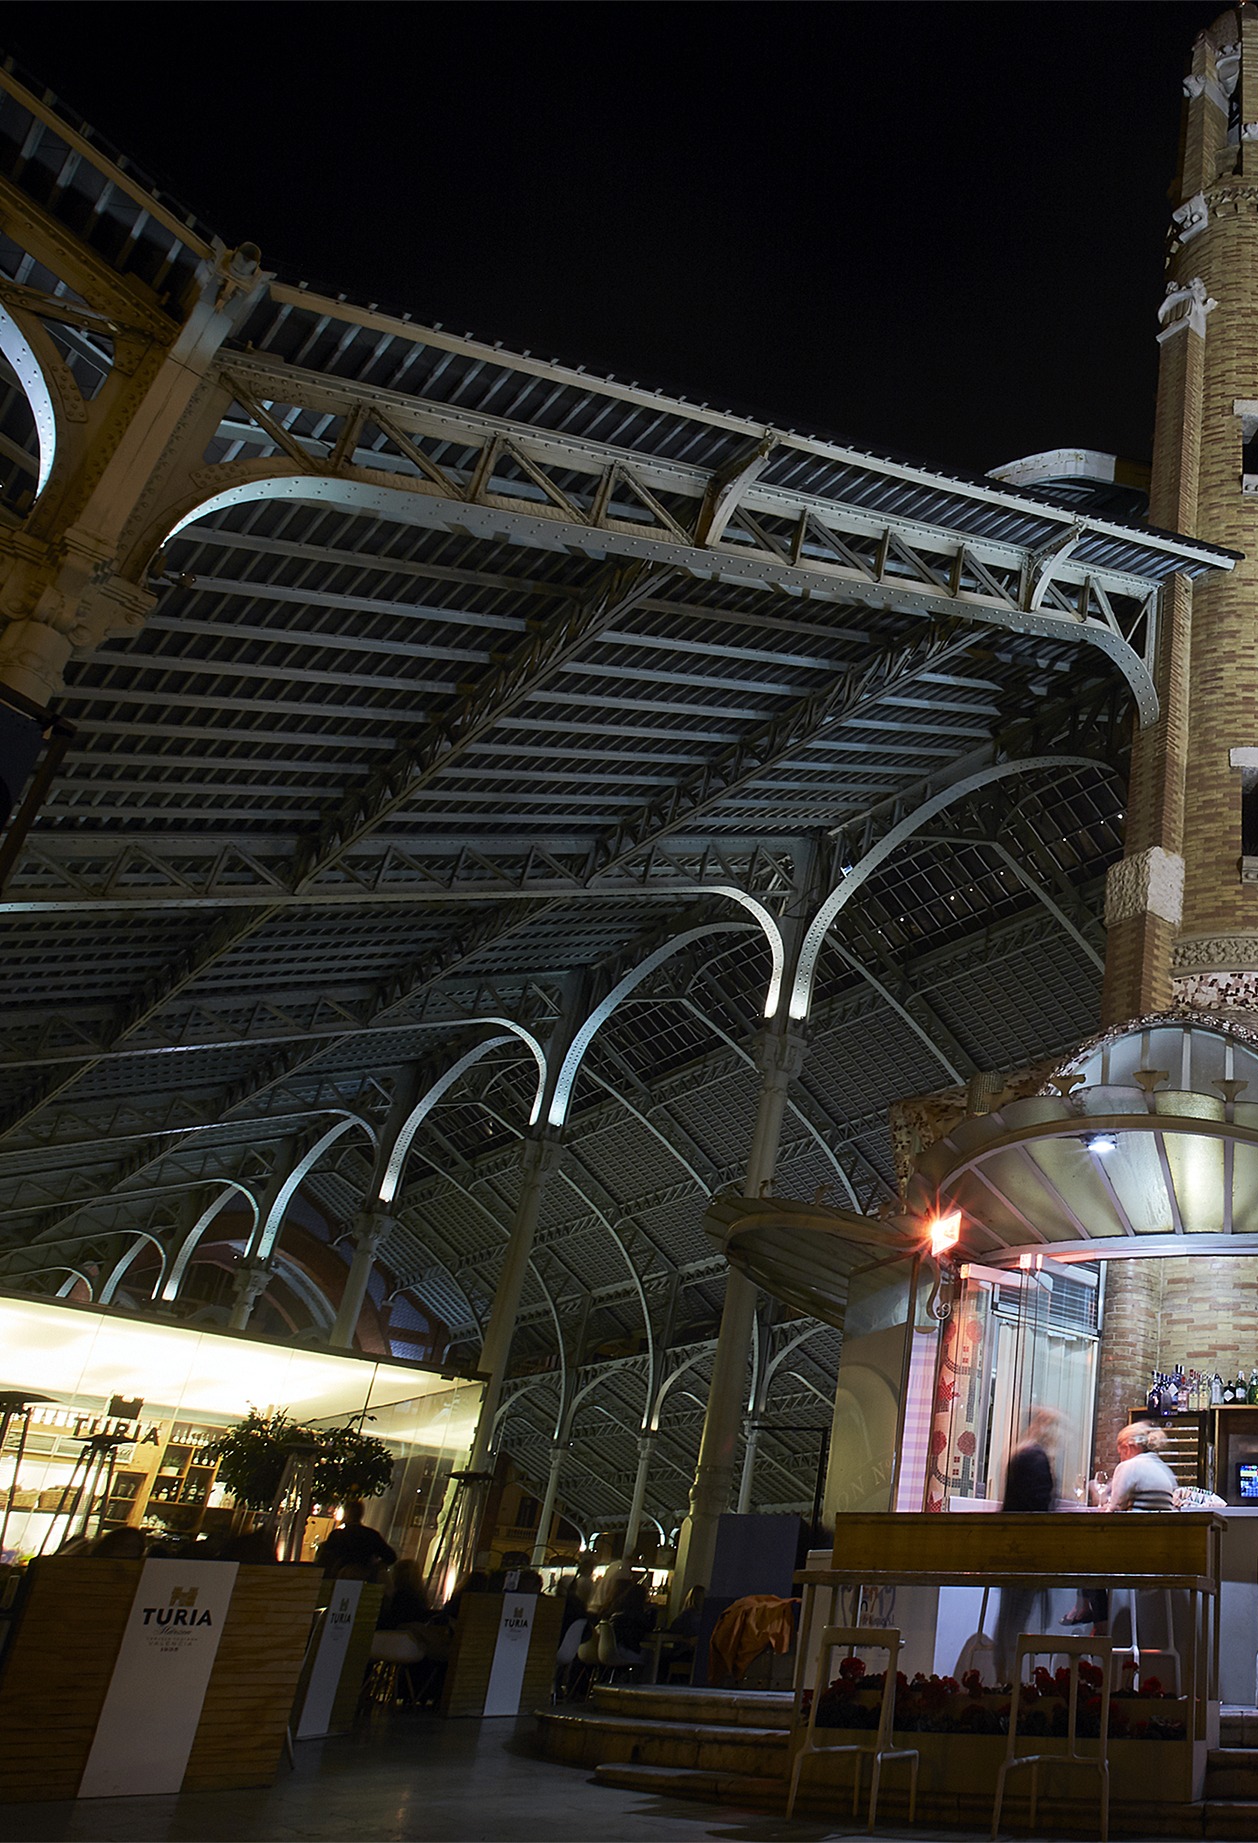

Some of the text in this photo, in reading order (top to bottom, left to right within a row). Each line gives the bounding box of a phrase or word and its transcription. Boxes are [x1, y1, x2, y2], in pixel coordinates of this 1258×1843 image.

[74, 1417, 160, 1446] TURIA
[143, 1608, 212, 1626] TURIA
[330, 1612, 351, 1624] TURIA
[504, 1618, 528, 1628] TURIA
